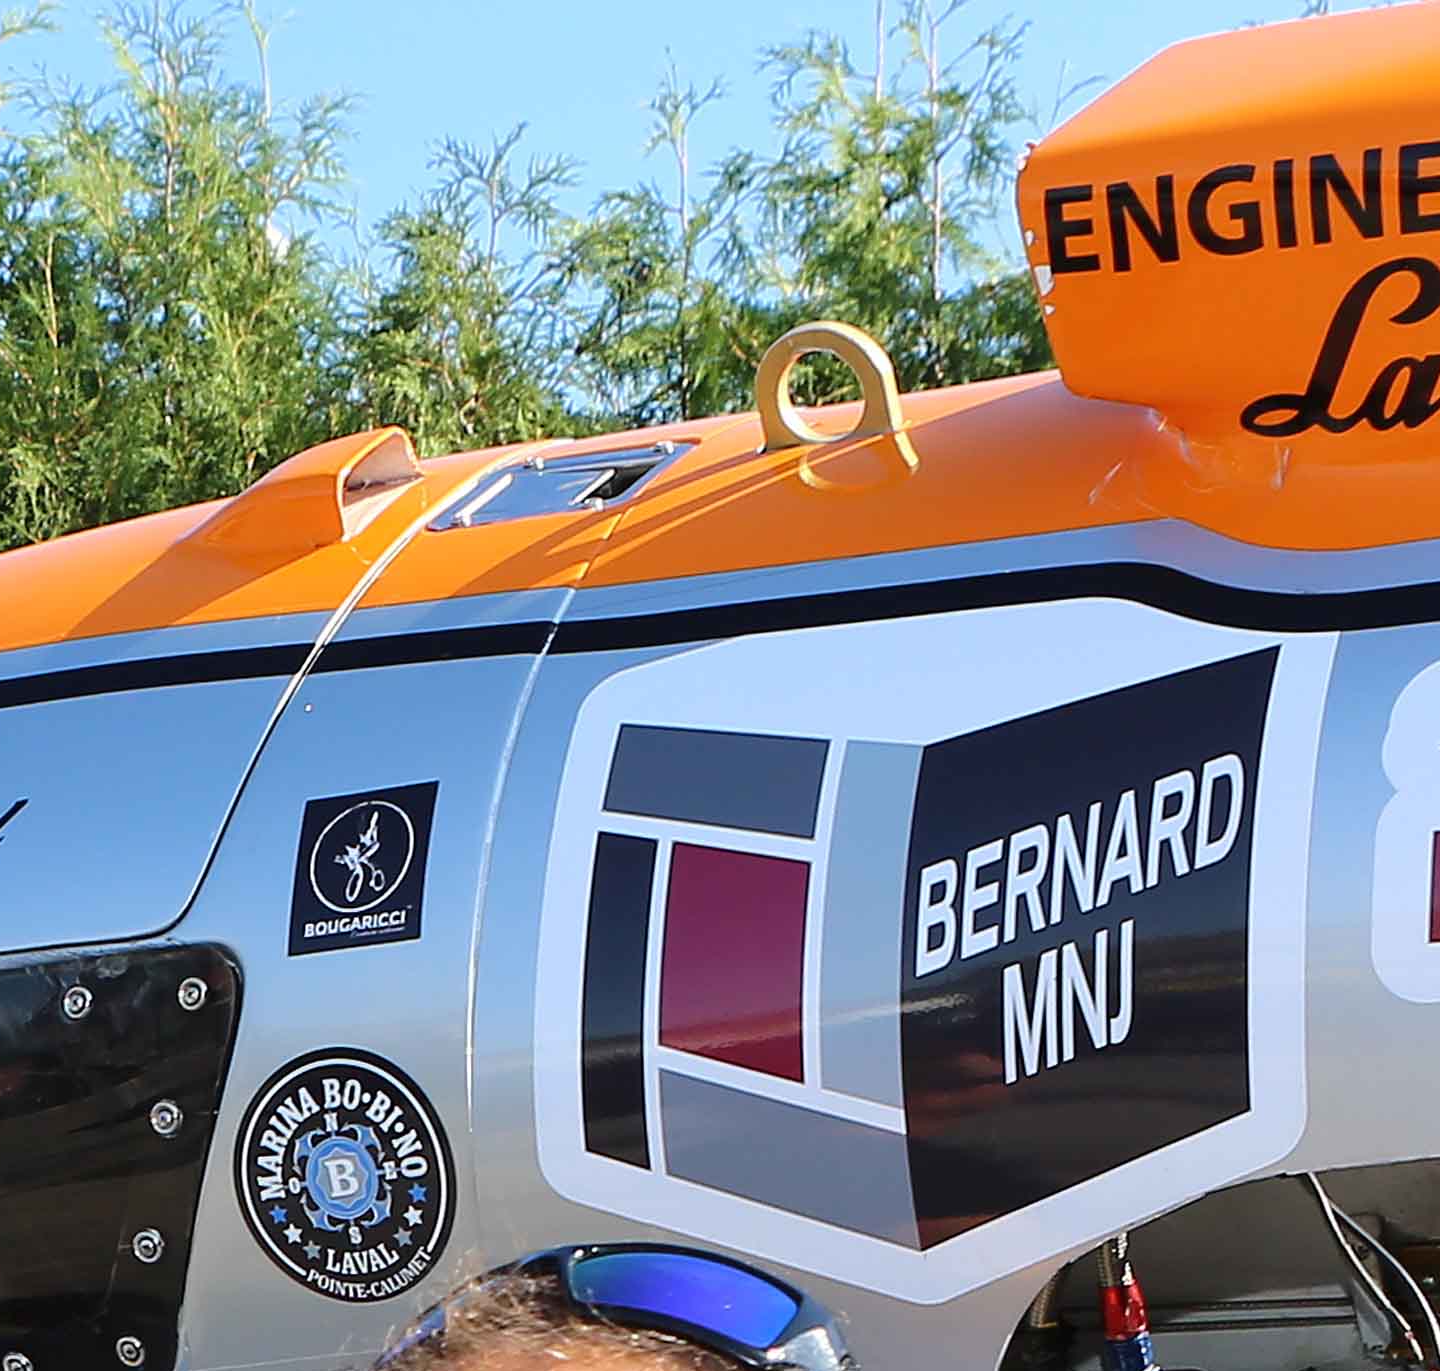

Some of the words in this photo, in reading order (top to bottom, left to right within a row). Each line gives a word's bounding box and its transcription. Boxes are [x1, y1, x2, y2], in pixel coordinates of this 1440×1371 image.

[914, 752, 1246, 979] BERNARD
[303, 910, 407, 938] BOUGARICCI
[1002, 918, 1136, 1086] MNJ
[257, 1086, 320, 1202] MARINA
[323, 1157, 360, 1199] B
[306, 1246, 432, 1299] POINTE-CALUMET
[326, 1242, 400, 1276] LAVAL
